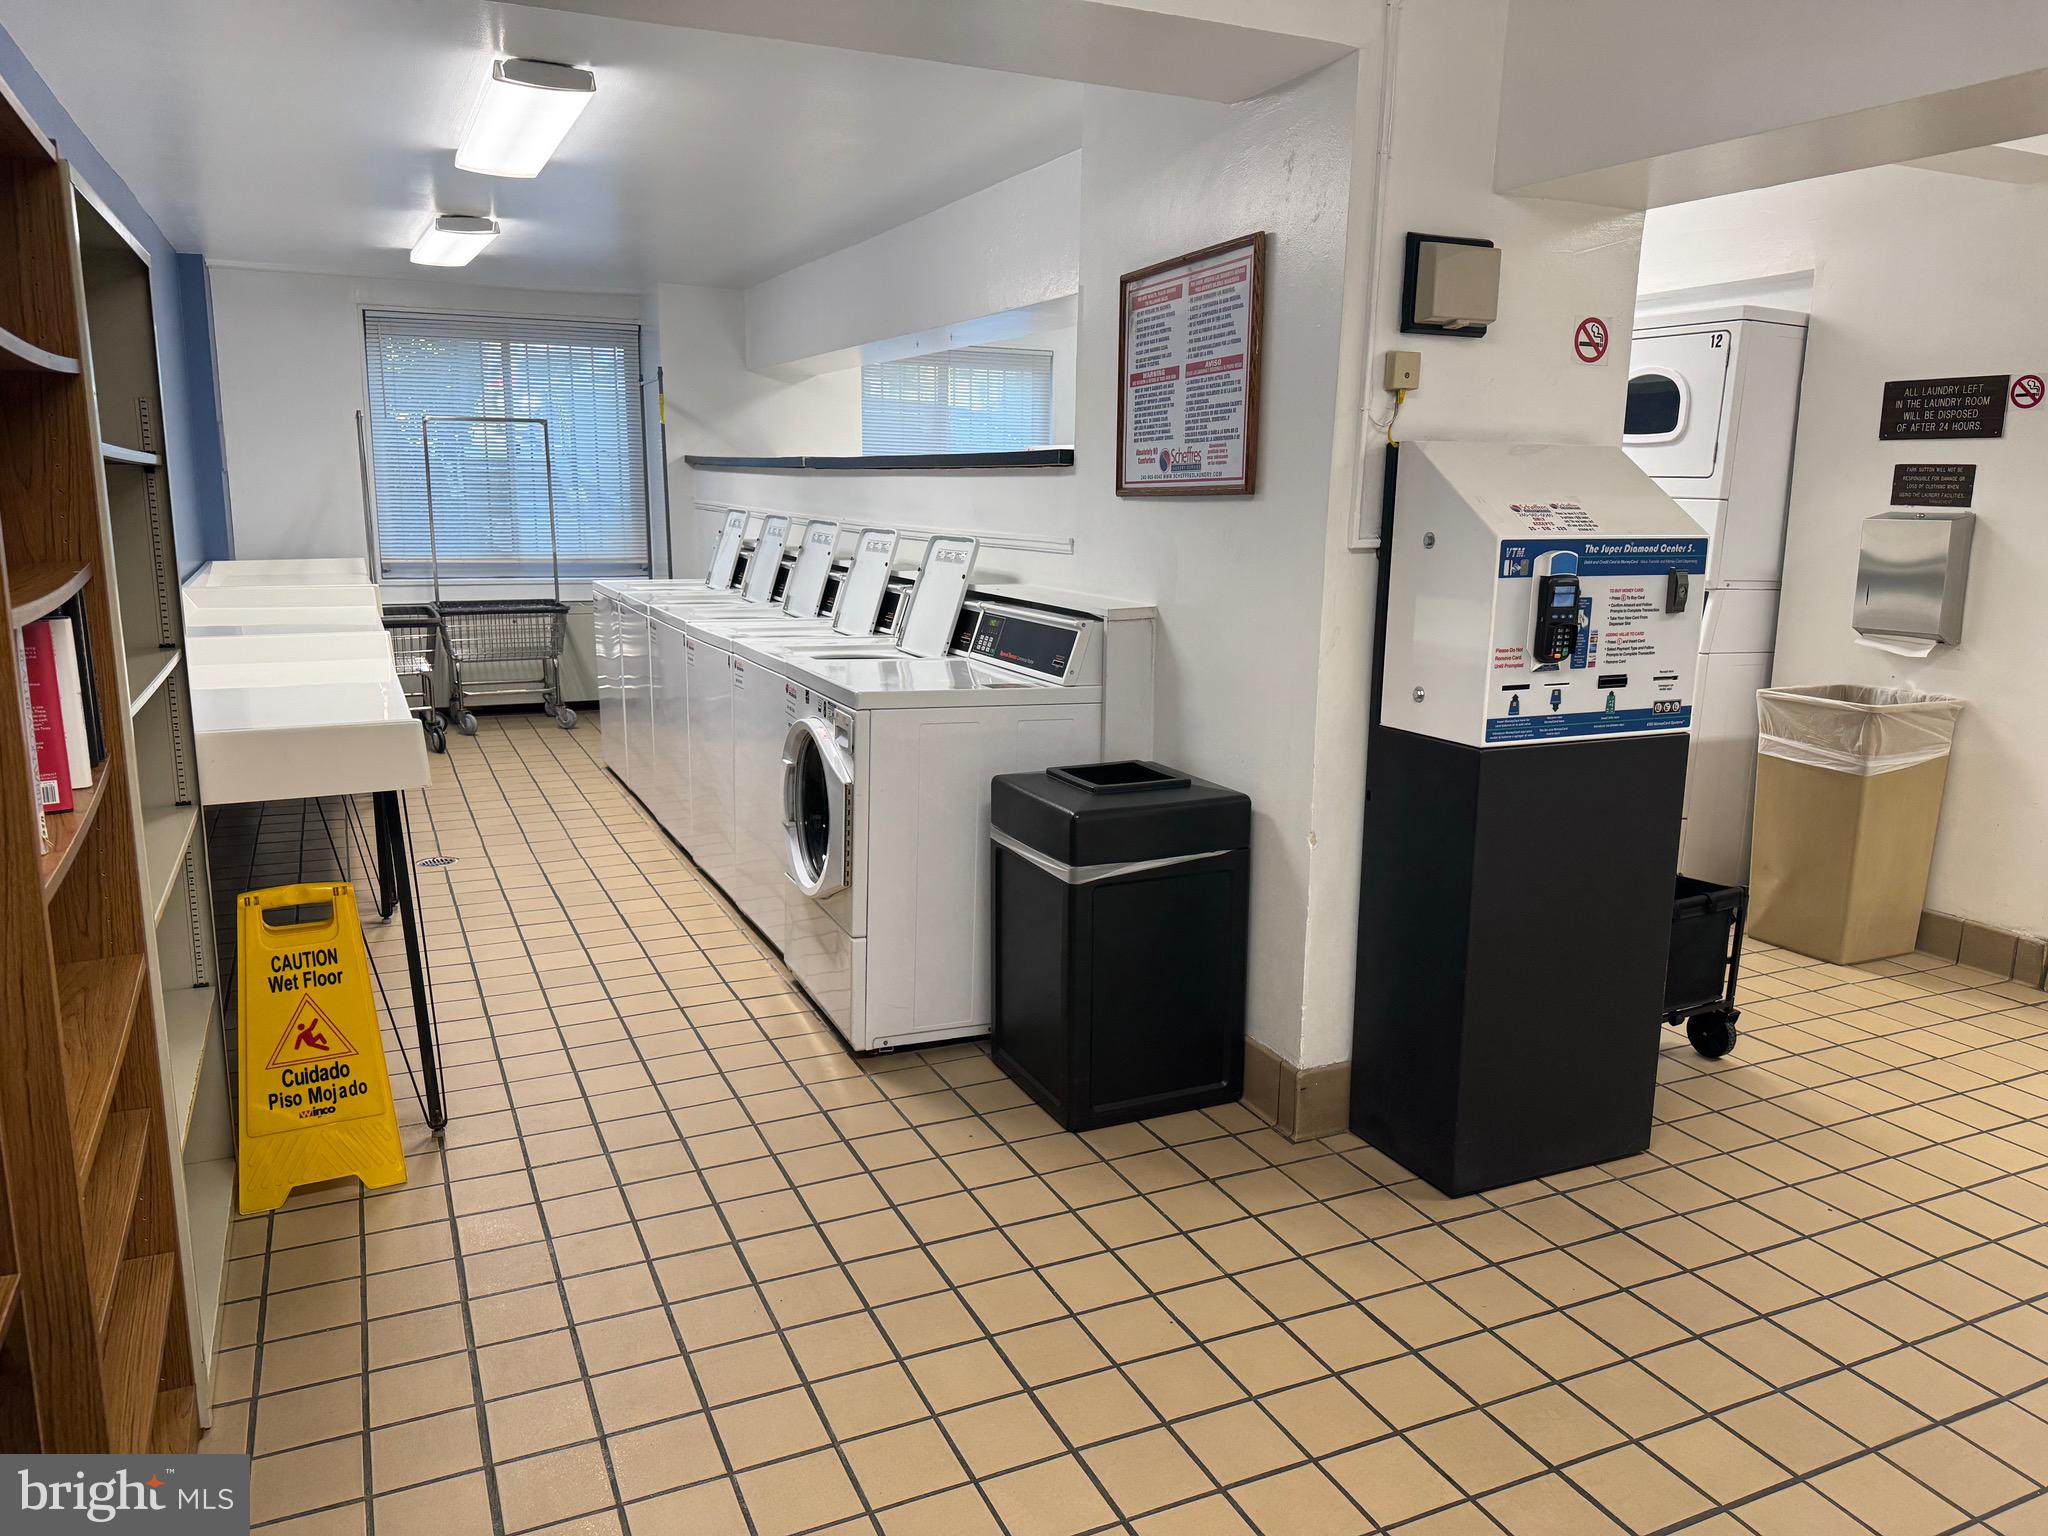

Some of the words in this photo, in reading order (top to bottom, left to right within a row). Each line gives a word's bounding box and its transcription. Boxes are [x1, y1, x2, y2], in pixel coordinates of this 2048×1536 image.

[1711, 334, 1723, 348] 12
[1205, 359, 1222, 368] AVISO
[1143, 369, 1166, 379] WARNING
[1904, 387, 1918, 397] ALL
[1921, 385, 1959, 396] LAUNDRY
[1962, 383, 1984, 394] LEFT
[1895, 400, 1903, 409] IN
[1906, 398, 1921, 409] THE
[1924, 397, 1962, 408] LAUNDRY
[1965, 395, 1991, 406] ROOM
[1903, 411, 1920, 420] WILL
[1924, 410, 1935, 420] BE
[1938, 408, 1979, 419] DISPOSED
[1896, 423, 1908, 433] OF
[1910, 422, 1936, 432] AFTER
[1939, 422, 1949, 431] 24
[1952, 421, 1982, 431] HOURS.
[1506, 547, 1525, 557] VTM
[1585, 544, 1599, 553] The
[1600, 543, 1623, 555] Super
[1623, 542, 1659, 553] Diamond
[1660, 543, 1686, 553] Center
[271, 948, 338, 973] CAUTION
[268, 974, 299, 993] Wet
[303, 970, 343, 989] Floor
[281, 1060, 350, 1088] Cuidado
[268, 1092, 302, 1110] Piso
[308, 1079, 368, 1105] Mojado
